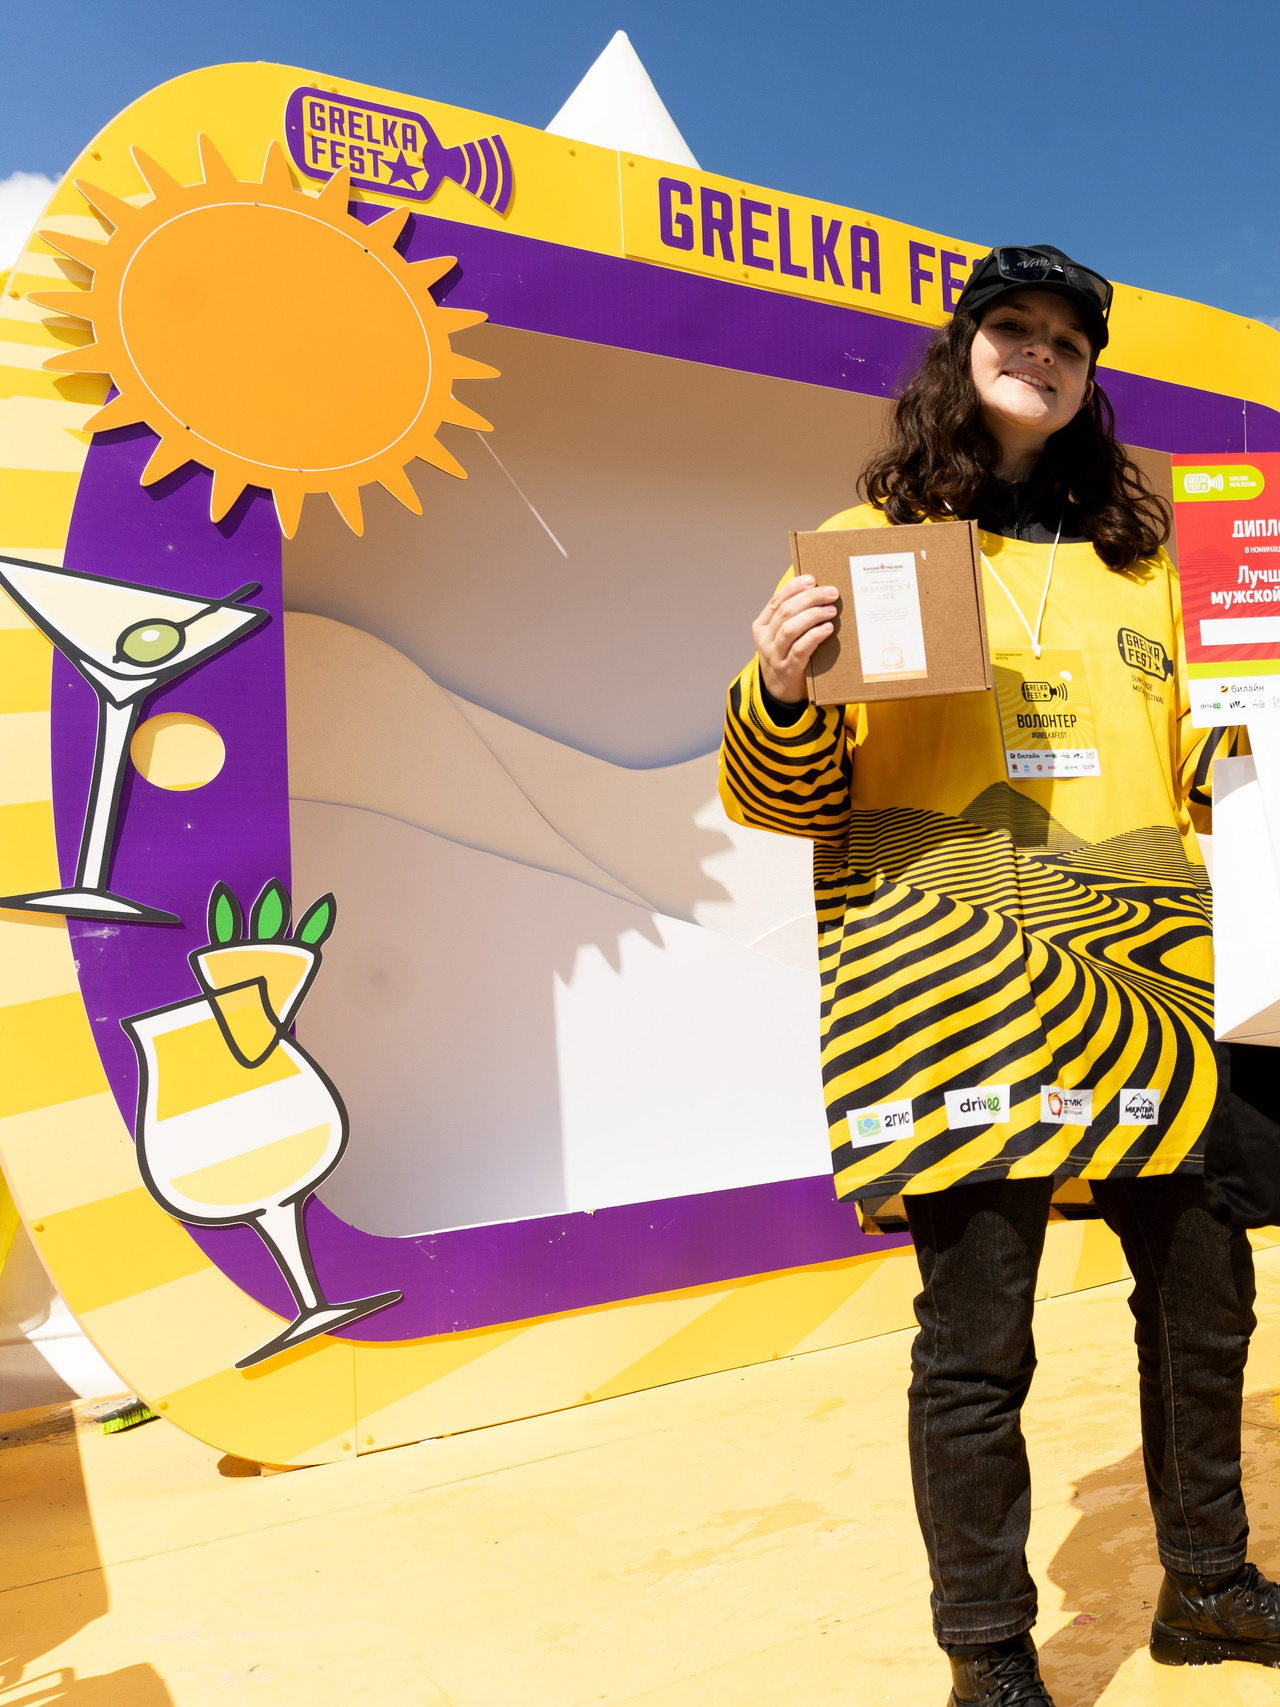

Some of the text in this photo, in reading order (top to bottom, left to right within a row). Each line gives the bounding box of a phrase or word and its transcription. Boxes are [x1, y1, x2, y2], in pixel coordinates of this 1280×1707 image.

[309, 101, 418, 153] GRELKA
[311, 136, 384, 178] FEST
[658, 176, 980, 315] GRELKA FE
[1244, 546, 1249, 554] в
[1128, 648, 1152, 669] FEST
[1025, 684, 1048, 692] GRELKA
[1231, 684, 1265, 693] билайн
[1016, 713, 1077, 728] ВОЛОНТЕР
[1032, 731, 1067, 739] #GRELKAFEST
[960, 1097, 1001, 1113] drivee
[884, 1111, 910, 1128] 2ГИС
